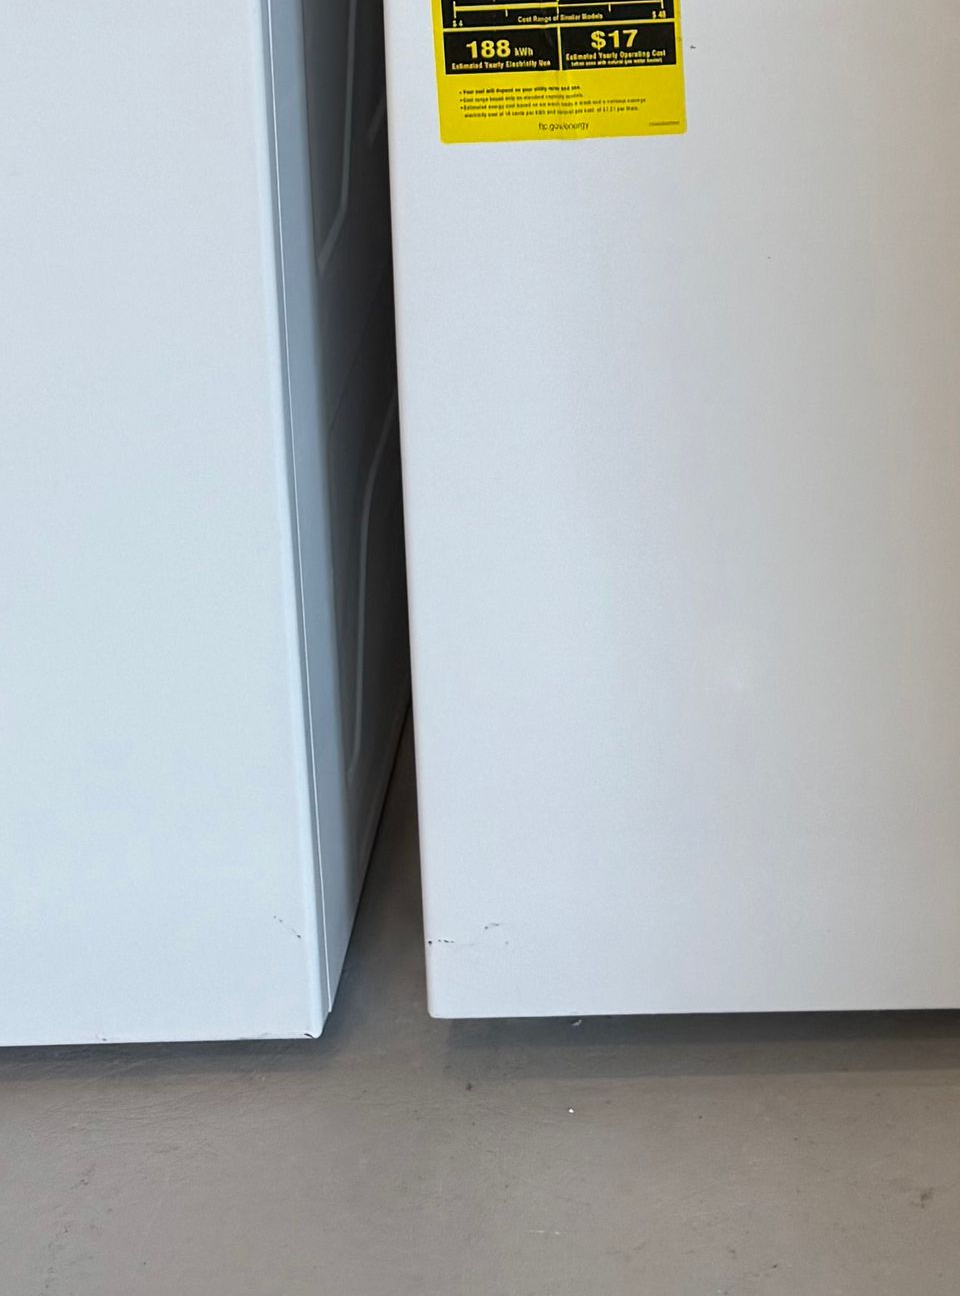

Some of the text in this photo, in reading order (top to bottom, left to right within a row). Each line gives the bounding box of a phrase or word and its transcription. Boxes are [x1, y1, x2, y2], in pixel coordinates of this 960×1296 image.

[466, 39, 534, 59] 188 kWh
[590, 29, 639, 51] $17
